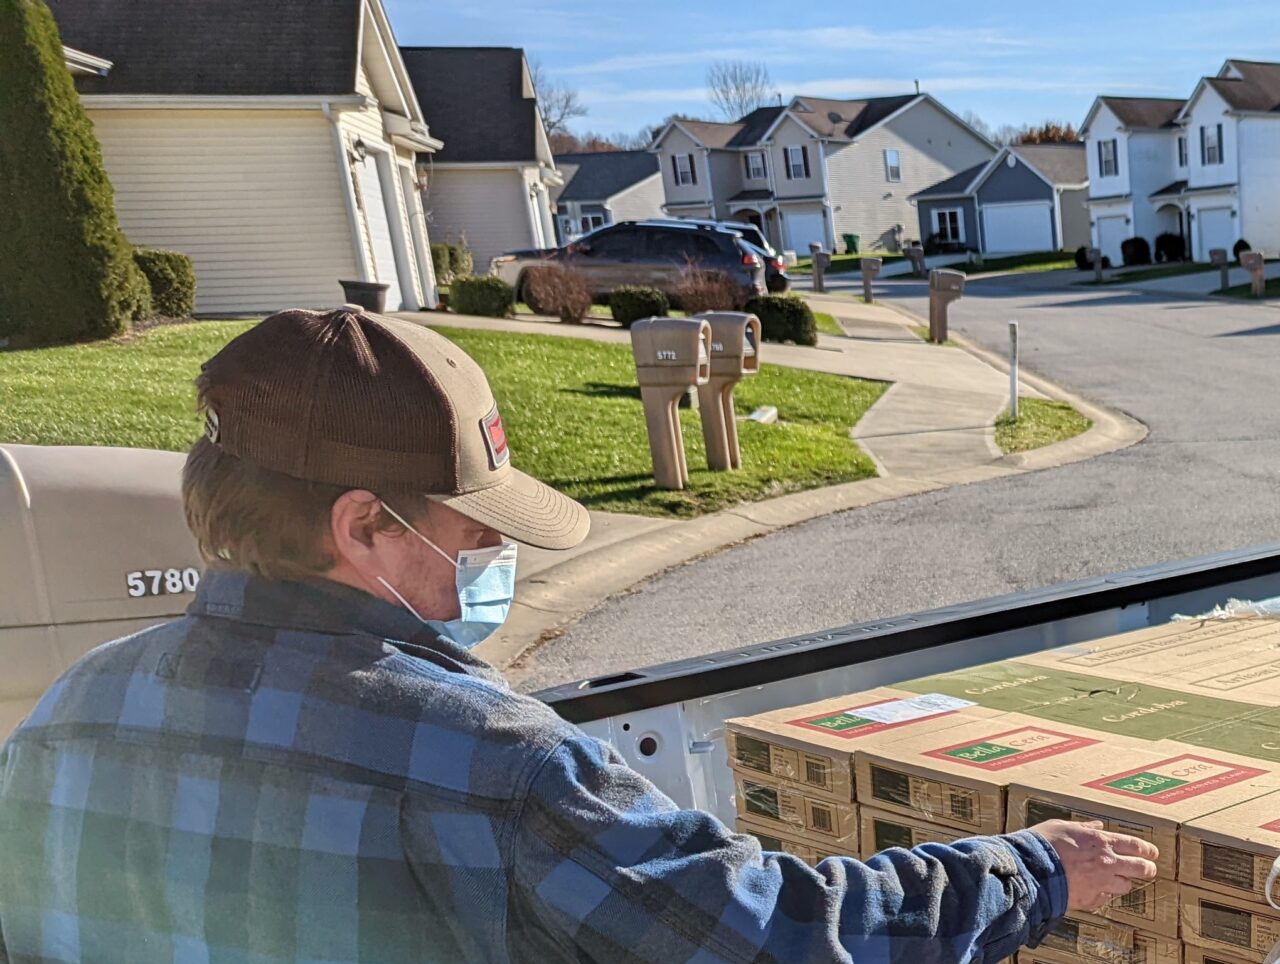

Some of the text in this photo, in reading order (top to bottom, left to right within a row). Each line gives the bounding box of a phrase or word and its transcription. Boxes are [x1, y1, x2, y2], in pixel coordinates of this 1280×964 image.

[657, 350, 676, 360] 5772
[127, 567, 200, 597] 5780
[964, 674, 1050, 695] Cordoba
[1102, 700, 1188, 723] Cordoba
[957, 733, 1050, 760] Bella Cera
[1122, 763, 1213, 793] Bella Cera
